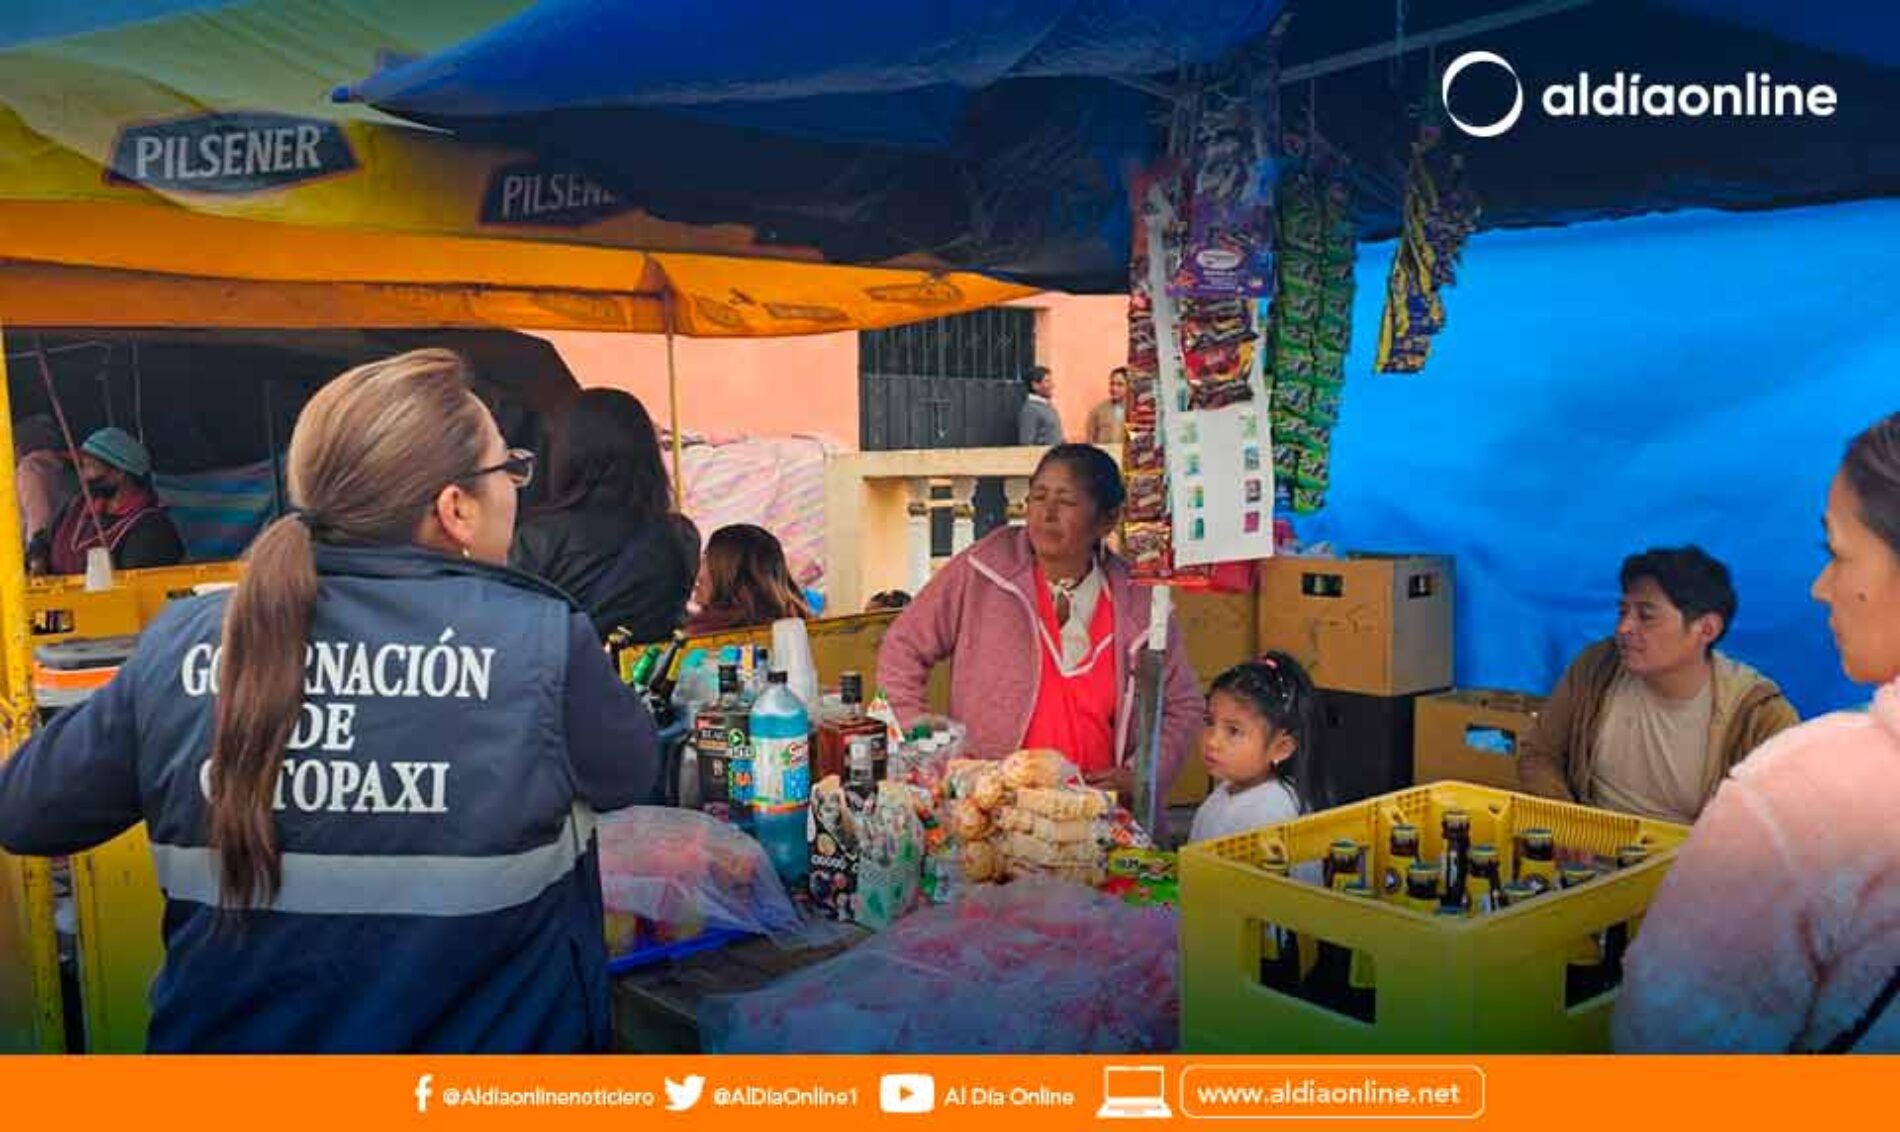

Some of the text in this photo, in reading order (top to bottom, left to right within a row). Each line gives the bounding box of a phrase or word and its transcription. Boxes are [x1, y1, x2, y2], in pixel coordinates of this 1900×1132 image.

[136, 124, 324, 180] PILSENER
[502, 173, 618, 219] PILSEN
[181, 627, 496, 700] GNACIÓN
[287, 702, 356, 751] DE
[199, 758, 450, 812] TOPAXI
